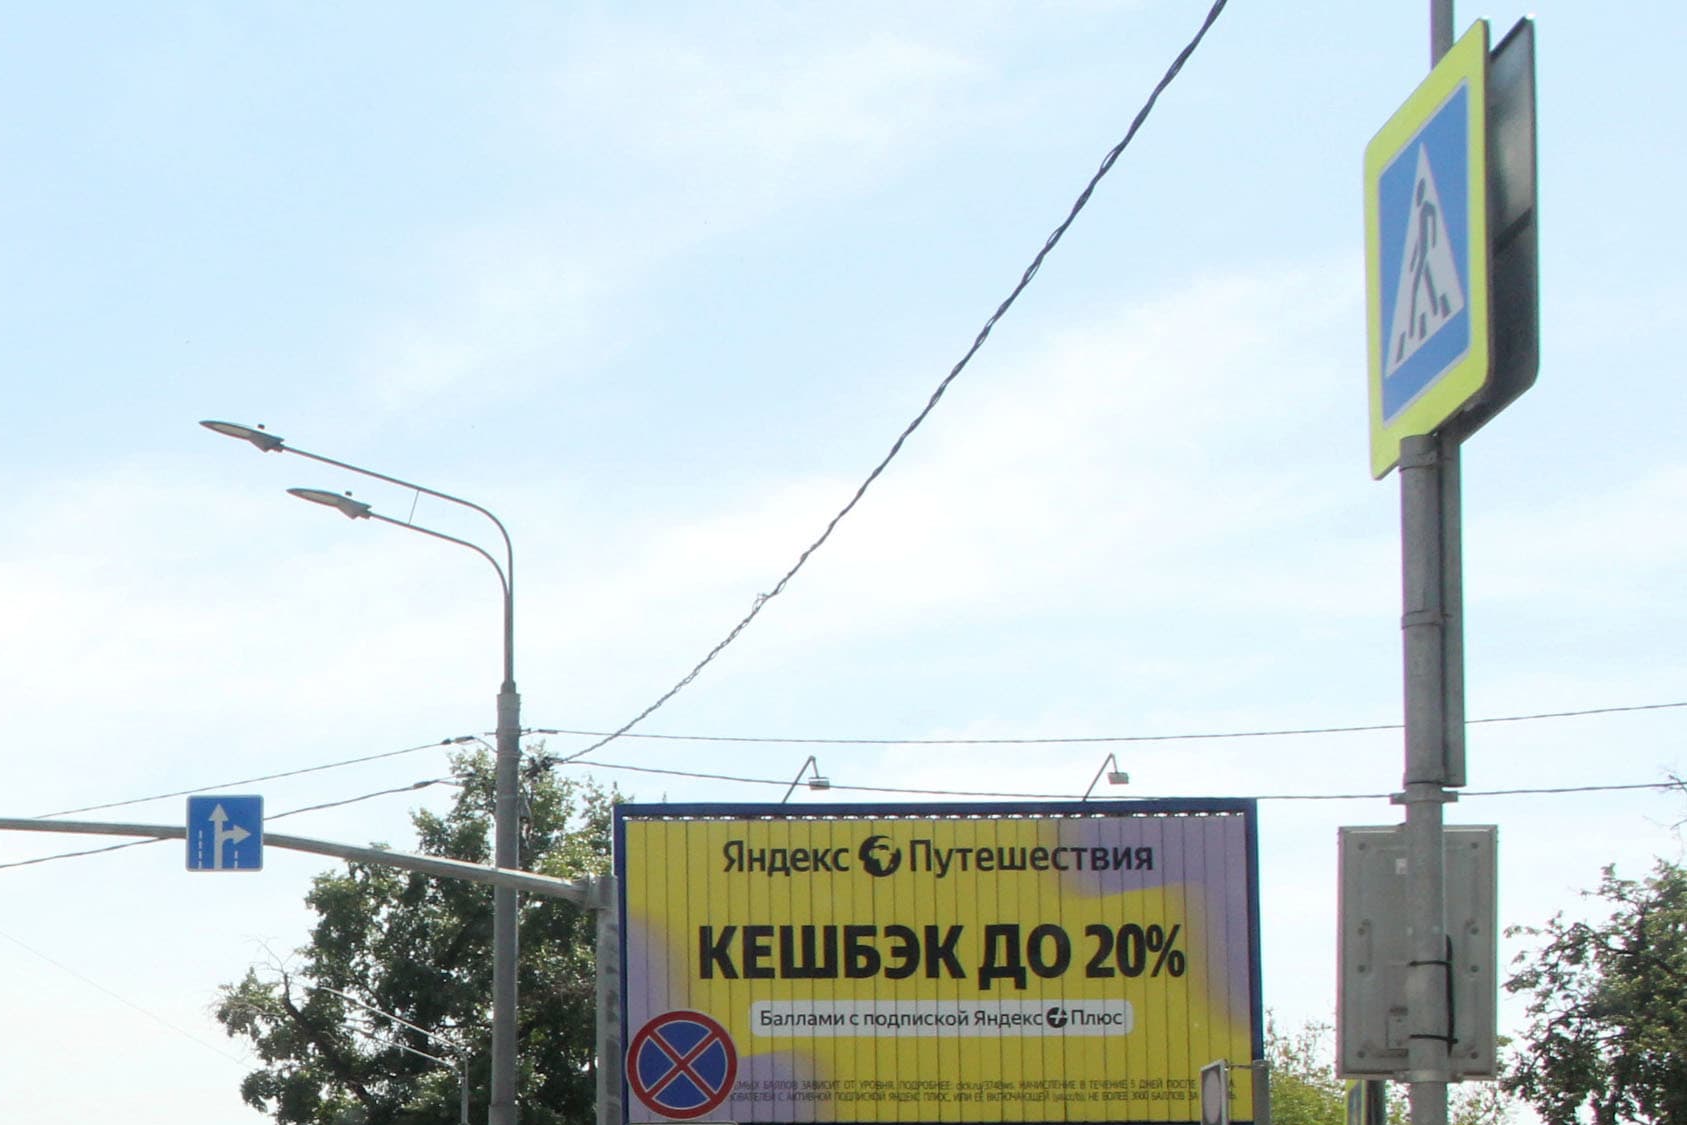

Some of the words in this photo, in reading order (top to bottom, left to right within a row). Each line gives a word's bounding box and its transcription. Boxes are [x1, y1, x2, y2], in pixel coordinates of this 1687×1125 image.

[723, 840, 850, 876] Яндекс
[910, 839, 1154, 878] Путешествия
[699, 925, 968, 979] КЕШБЭК
[977, 923, 1072, 990] ДО
[1084, 923, 1186, 978] 20%
[760, 1009, 845, 1027] Баллами
[849, 1015, 859, 1027] с
[864, 1010, 970, 1031] подпиской
[974, 1011, 1044, 1030] Яндекс
[1071, 1009, 1123, 1027] Плюс
